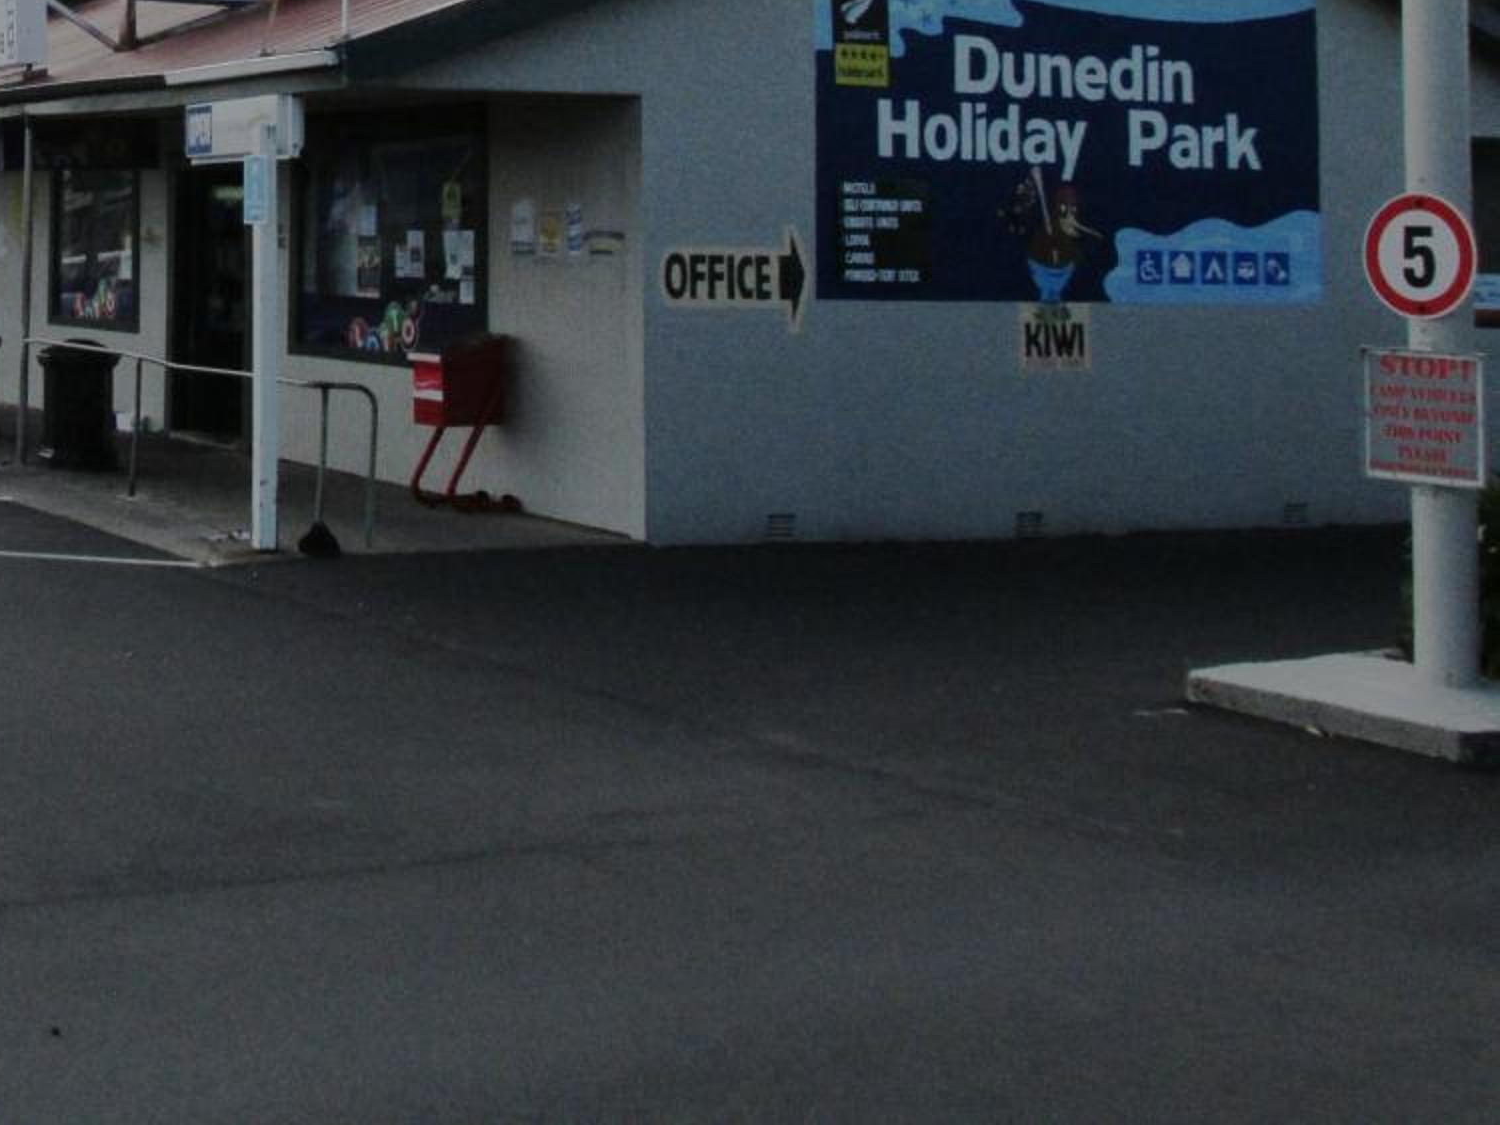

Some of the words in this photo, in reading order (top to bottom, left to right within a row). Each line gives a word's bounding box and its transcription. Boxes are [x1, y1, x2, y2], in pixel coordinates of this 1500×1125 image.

[954, 34, 1195, 104] Dunedin
[877, 98, 1088, 182] Holiday
[1128, 107, 1262, 171] Park
[663, 252, 773, 300] OFFICE
[1402, 225, 1436, 289] 5
[1024, 321, 1085, 358] KIWI
